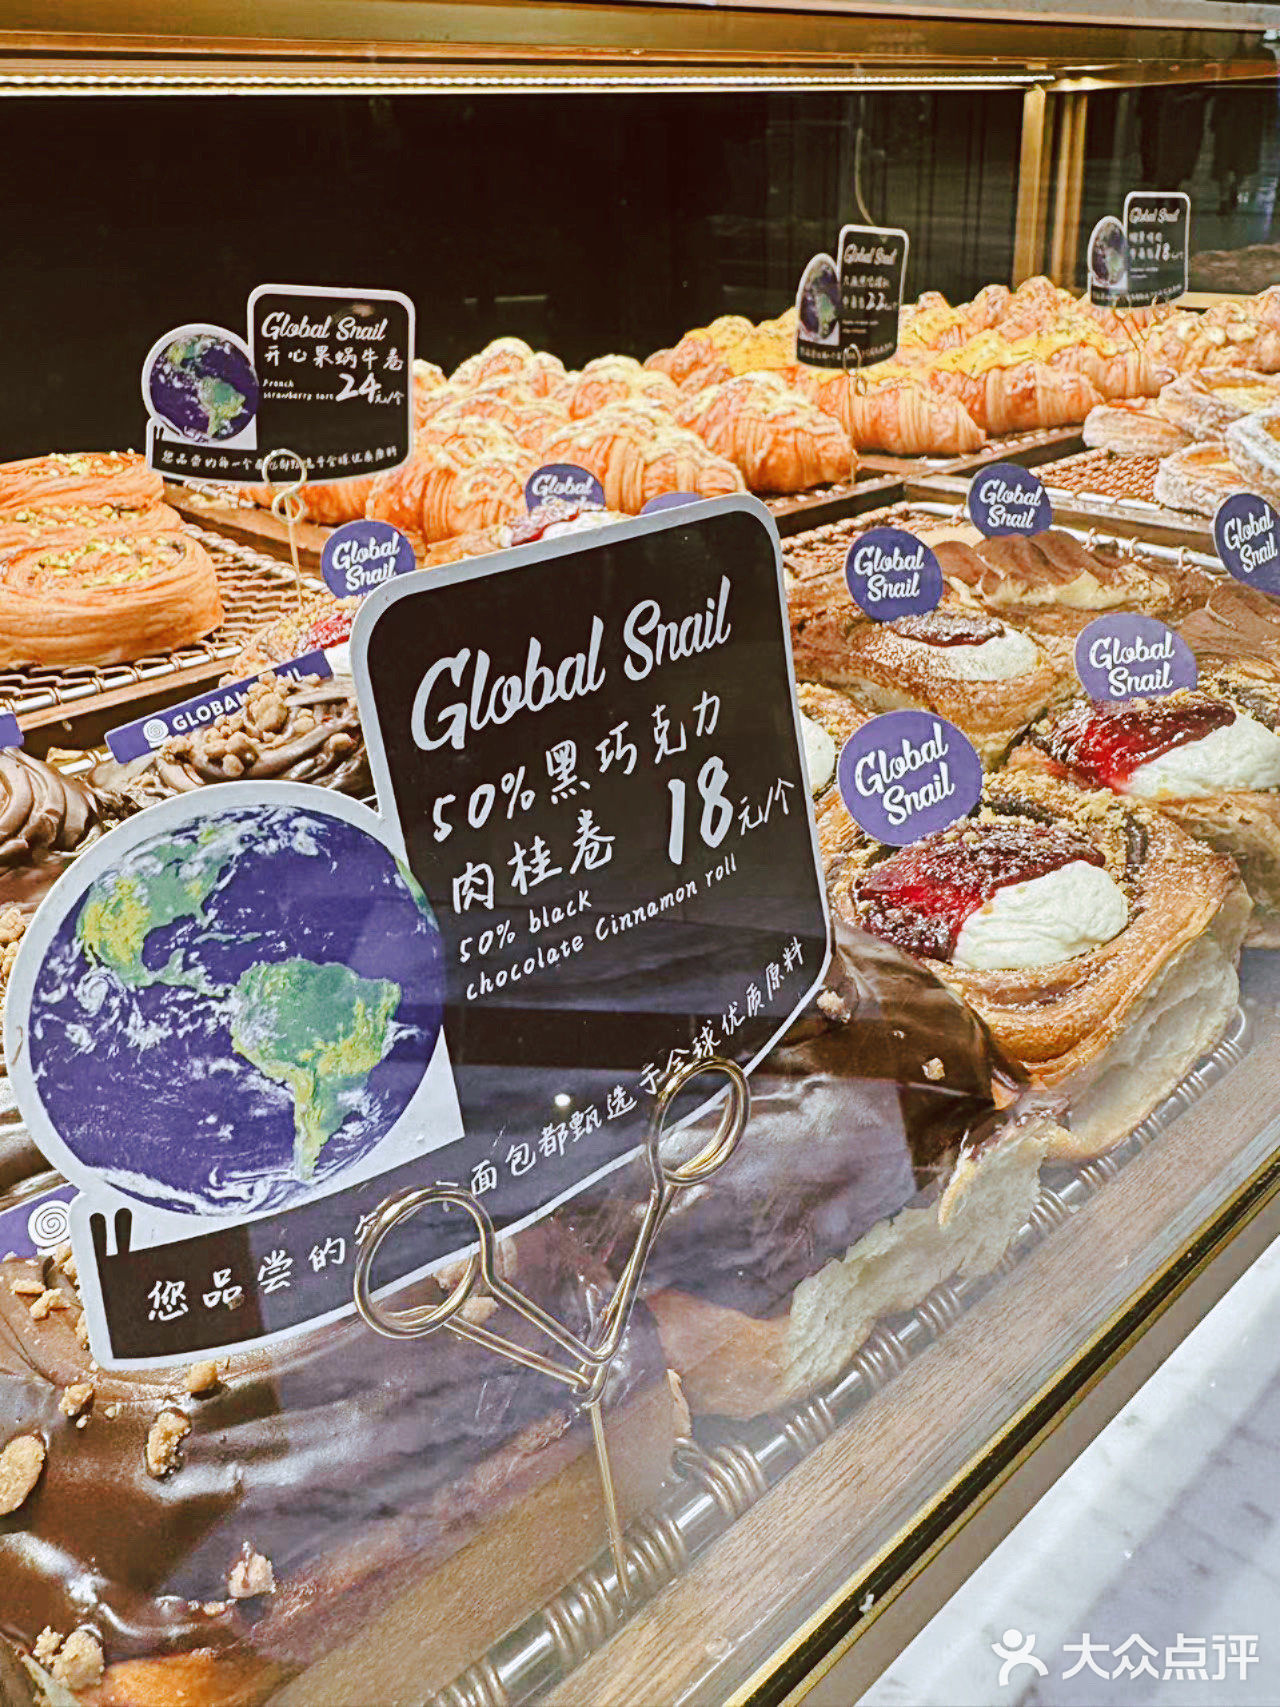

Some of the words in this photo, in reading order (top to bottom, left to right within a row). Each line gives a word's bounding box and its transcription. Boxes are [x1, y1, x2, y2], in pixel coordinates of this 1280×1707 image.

[261, 312, 331, 341] Global
[335, 316, 389, 342] Snail
[531, 474, 595, 496] Global
[979, 479, 1041, 507] Global
[987, 504, 1034, 529] Snail
[1224, 503, 1274, 550] Global
[332, 532, 400, 571] Global
[853, 545, 925, 576] Global
[1240, 532, 1278, 574] Snail
[345, 559, 397, 592] Snail
[866, 571, 920, 602] Snail
[410, 615, 607, 752] Global
[623, 574, 732, 682] Snail
[1089, 631, 1175, 670] Global
[1108, 664, 1174, 697] Snail
[855, 722, 949, 797] Global
[882, 762, 955, 827] Snail
[451, 809, 616, 915] 肉桂卷
[459, 919, 517, 963] 50%
[529, 889, 593, 933] black
[465, 933, 584, 1001] chocolate
[704, 853, 738, 888] roll
